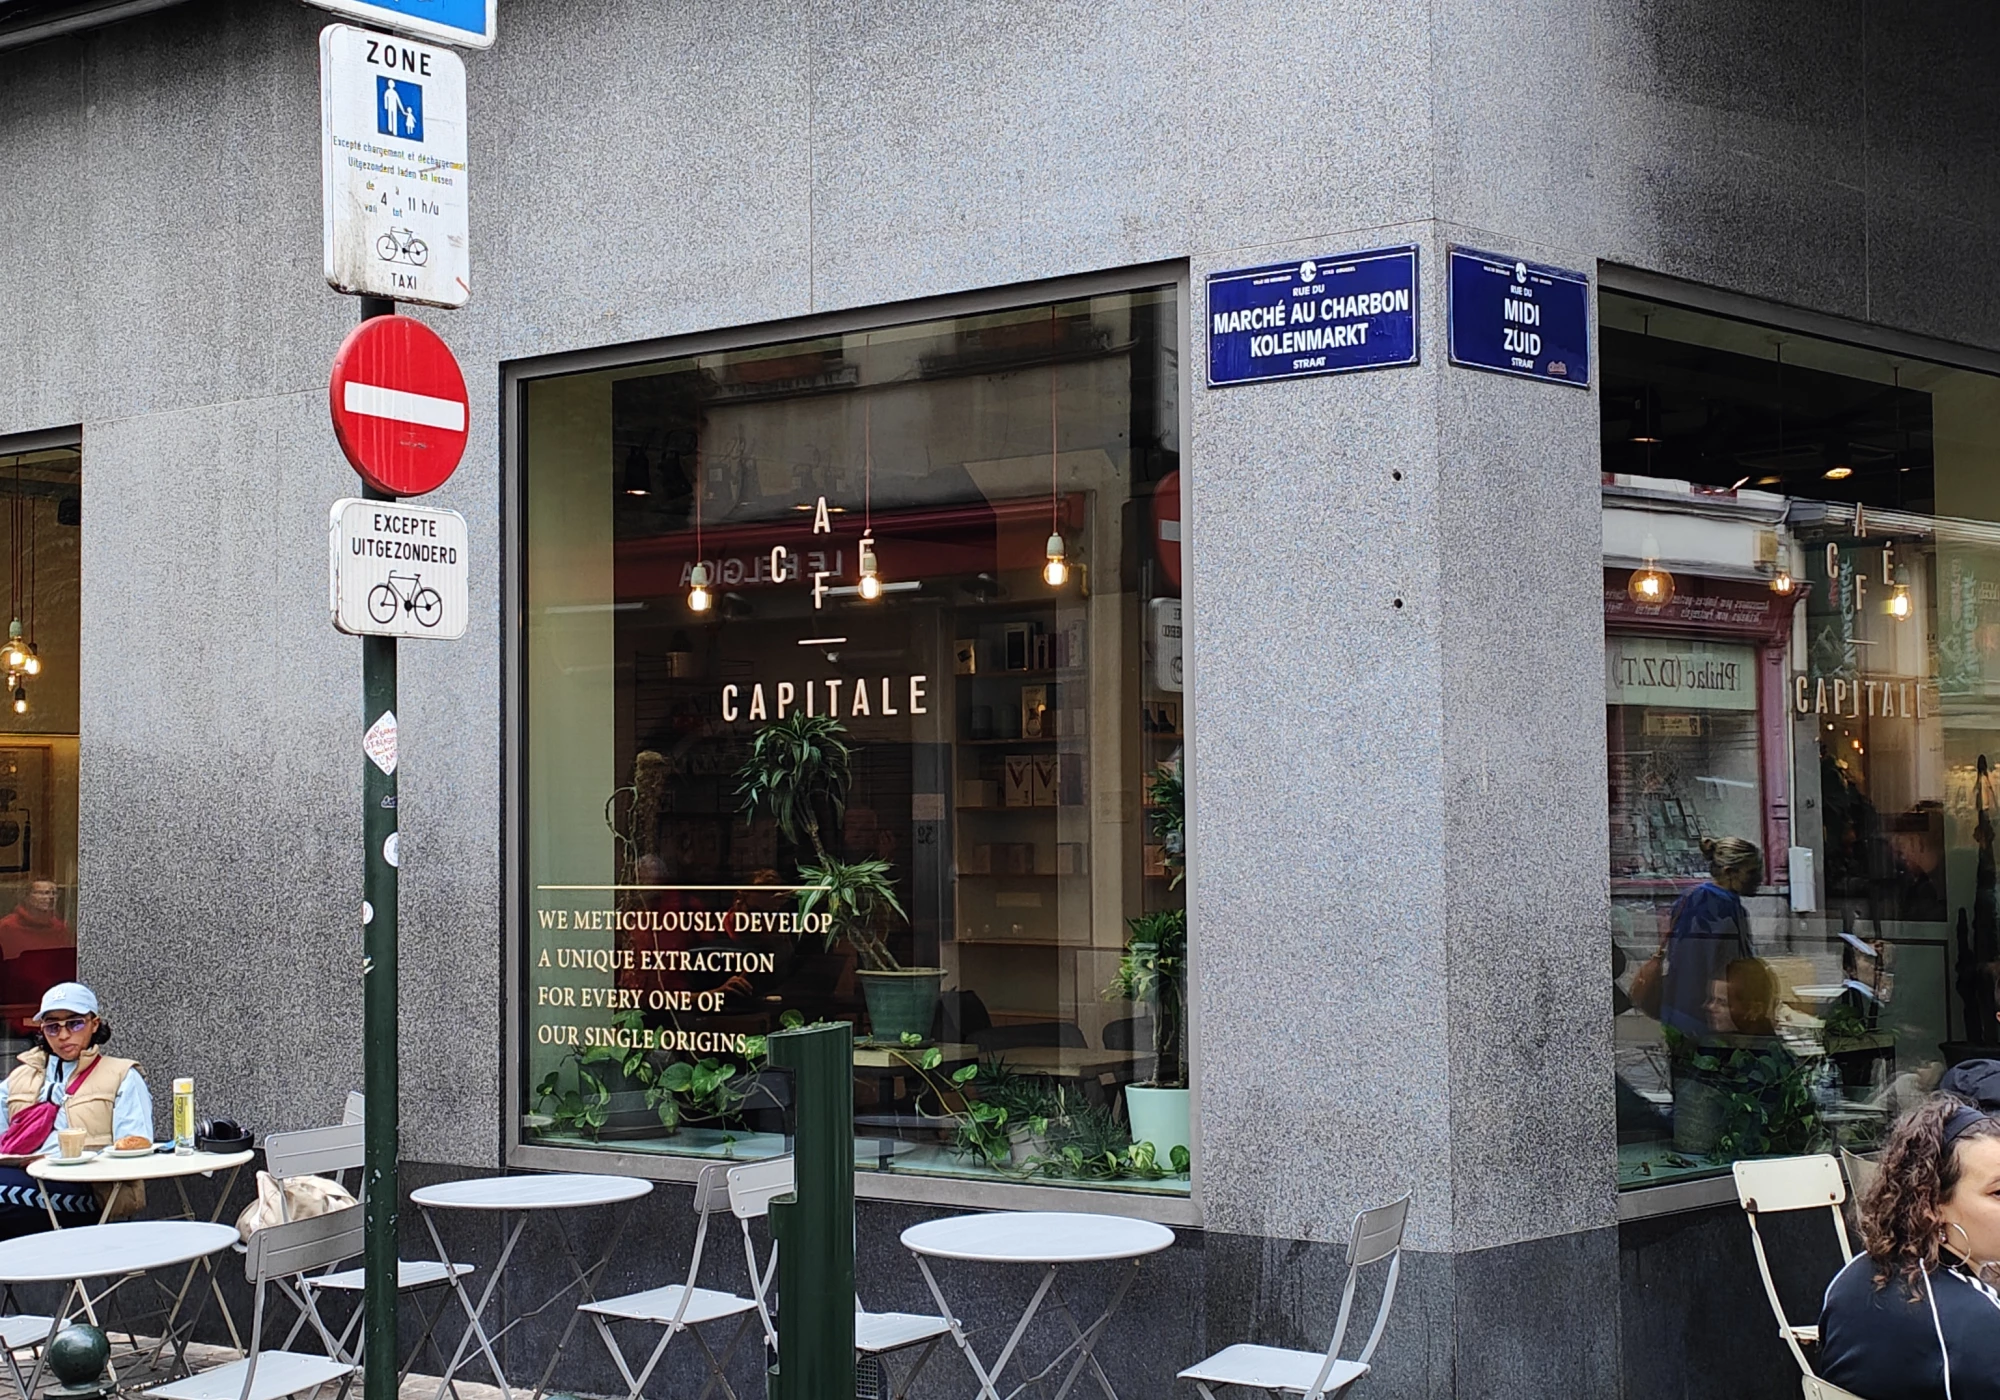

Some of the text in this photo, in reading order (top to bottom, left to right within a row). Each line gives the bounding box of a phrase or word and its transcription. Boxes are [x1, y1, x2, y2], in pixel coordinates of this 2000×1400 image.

[367, 40, 431, 77] ZONE
[363, 143, 405, 160] chargement
[408, 152, 415, 161] et
[348, 157, 394, 175] Uitgezonderd
[381, 192, 439, 216] 4 11 h/u
[391, 273, 417, 290] TAXI
[1293, 284, 1325, 297] RUE DU
[1510, 285, 1533, 297] RUE DU
[1214, 289, 1409, 335] MARCHÉ AU CHARBON
[1504, 298, 1540, 327] MIDI
[1251, 323, 1369, 358] KOLENMARKT
[1503, 328, 1541, 356] ZUID
[1293, 357, 1326, 370] STRAAT
[1511, 357, 1534, 370] STRAAT
[374, 513, 437, 537] EXCEPTE
[352, 537, 457, 565] UITGEZONDERD
[722, 675, 927, 722] CAPITALE
[538, 910, 833, 934] WE METICULOUSLY DEVELOP
[538, 948, 775, 973] A UNIQUE EXTRACTION
[538, 987, 725, 1012] FOR EVERY ONE OF
[538, 1025, 752, 1054] OUR SINGLE ORIGINS.
